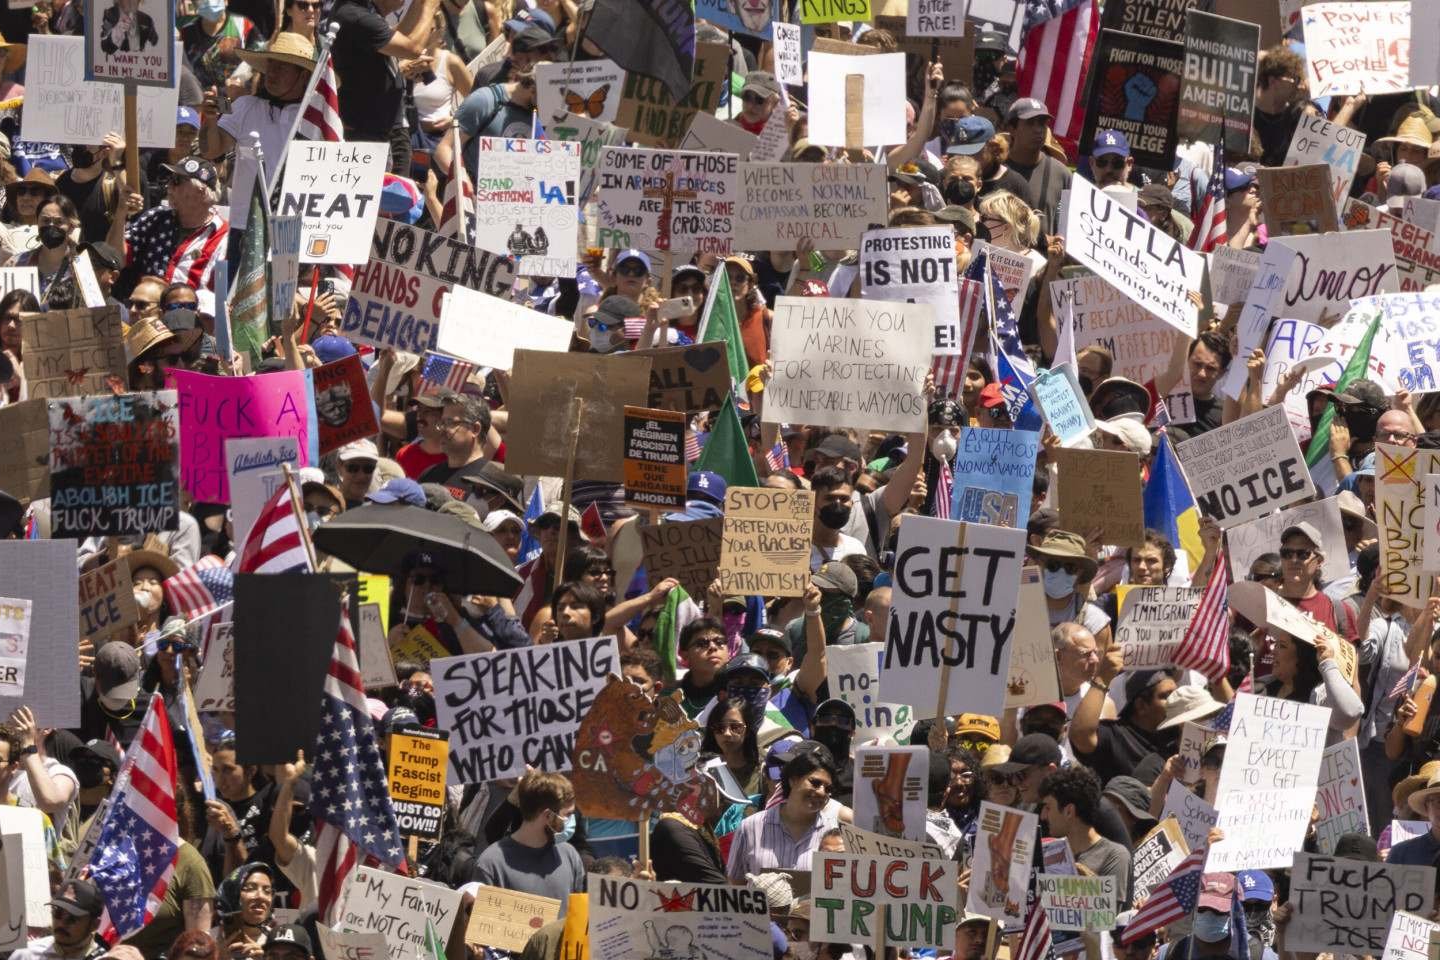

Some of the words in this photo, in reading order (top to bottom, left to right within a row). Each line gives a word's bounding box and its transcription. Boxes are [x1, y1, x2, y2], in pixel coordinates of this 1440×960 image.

[113, 54, 141, 65] WANT
[145, 56, 162, 67] YOU
[1187, 38, 1256, 61] IMMIGRANTS
[109, 66, 118, 76] IN
[122, 66, 137, 77] MY
[139, 68, 155, 78] JAIL
[1184, 55, 1254, 93] BUILT
[1184, 86, 1252, 114] AMERICA
[335, 147, 371, 163] take
[300, 173, 318, 185] my
[331, 170, 360, 185] city
[281, 193, 374, 218] NEAT
[864, 235, 951, 252] PROTESTING
[1090, 189, 1186, 276] UTLA
[1079, 212, 1150, 274] Stands
[1155, 270, 1198, 305] with
[865, 260, 893, 287] IS
[901, 257, 952, 284] NOT
[776, 305, 859, 331] THANK
[867, 311, 906, 334] YOU
[805, 333, 887, 357] MARINES
[772, 360, 811, 380] FOR
[823, 361, 924, 382] PROTECTING
[767, 388, 853, 412] VULNERABLE
[857, 394, 922, 415] WAYMOS
[55, 487, 130, 507] ABOLISH
[137, 484, 173, 505] ICE
[729, 492, 787, 511] STOP
[1197, 483, 1242, 520] NO
[1247, 459, 1304, 508] ICE
[51, 507, 109, 531] FUCK
[116, 508, 174, 532] TRUMP
[725, 519, 810, 535] PRETENDING
[726, 540, 757, 553] YOUR
[760, 536, 812, 552] RACISM
[733, 556, 750, 568] IS
[896, 546, 1016, 606] GET
[443, 637, 612, 705] SPEAKING
[451, 708, 501, 742] FOR
[504, 689, 595, 736] THOSE
[451, 745, 514, 783] WHO
[824, 859, 946, 902] FUCK
[815, 898, 956, 946] TRUMP
